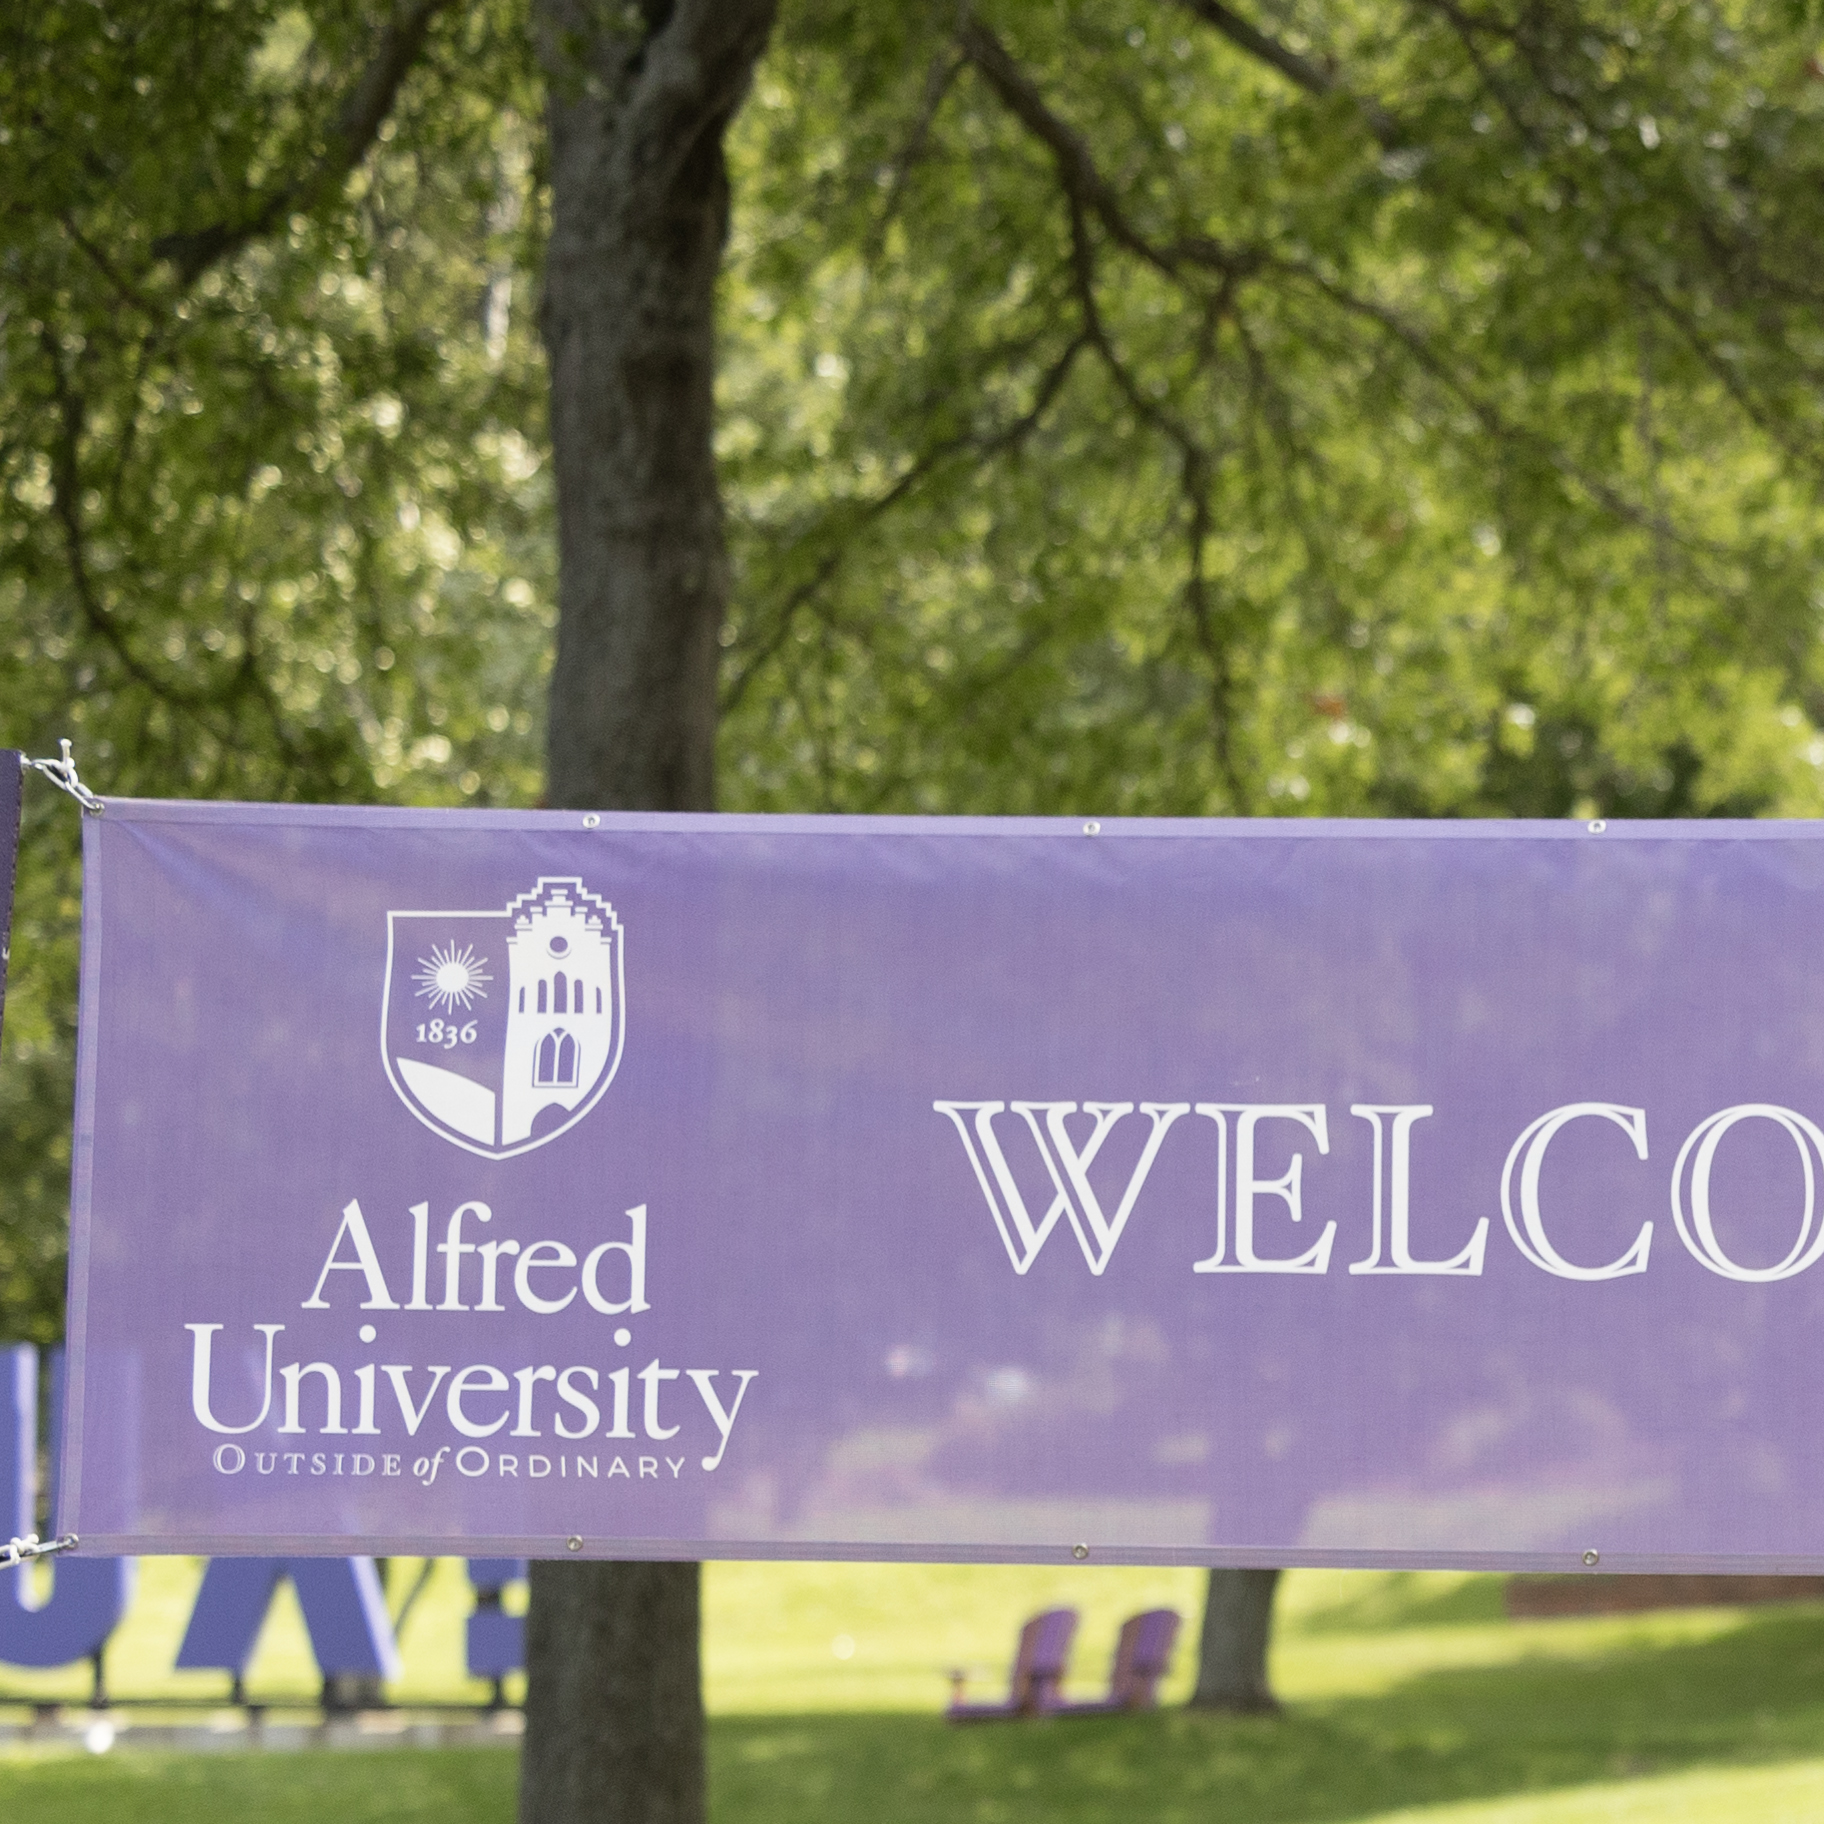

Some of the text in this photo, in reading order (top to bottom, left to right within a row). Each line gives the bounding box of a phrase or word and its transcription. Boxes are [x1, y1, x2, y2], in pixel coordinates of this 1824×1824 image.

[416, 1018, 478, 1049] 1836
[301, 1198, 651, 1315] Alfred
[184, 1323, 759, 1472] University
[212, 1443, 685, 1486] OUTSIDE of ORDINARY
